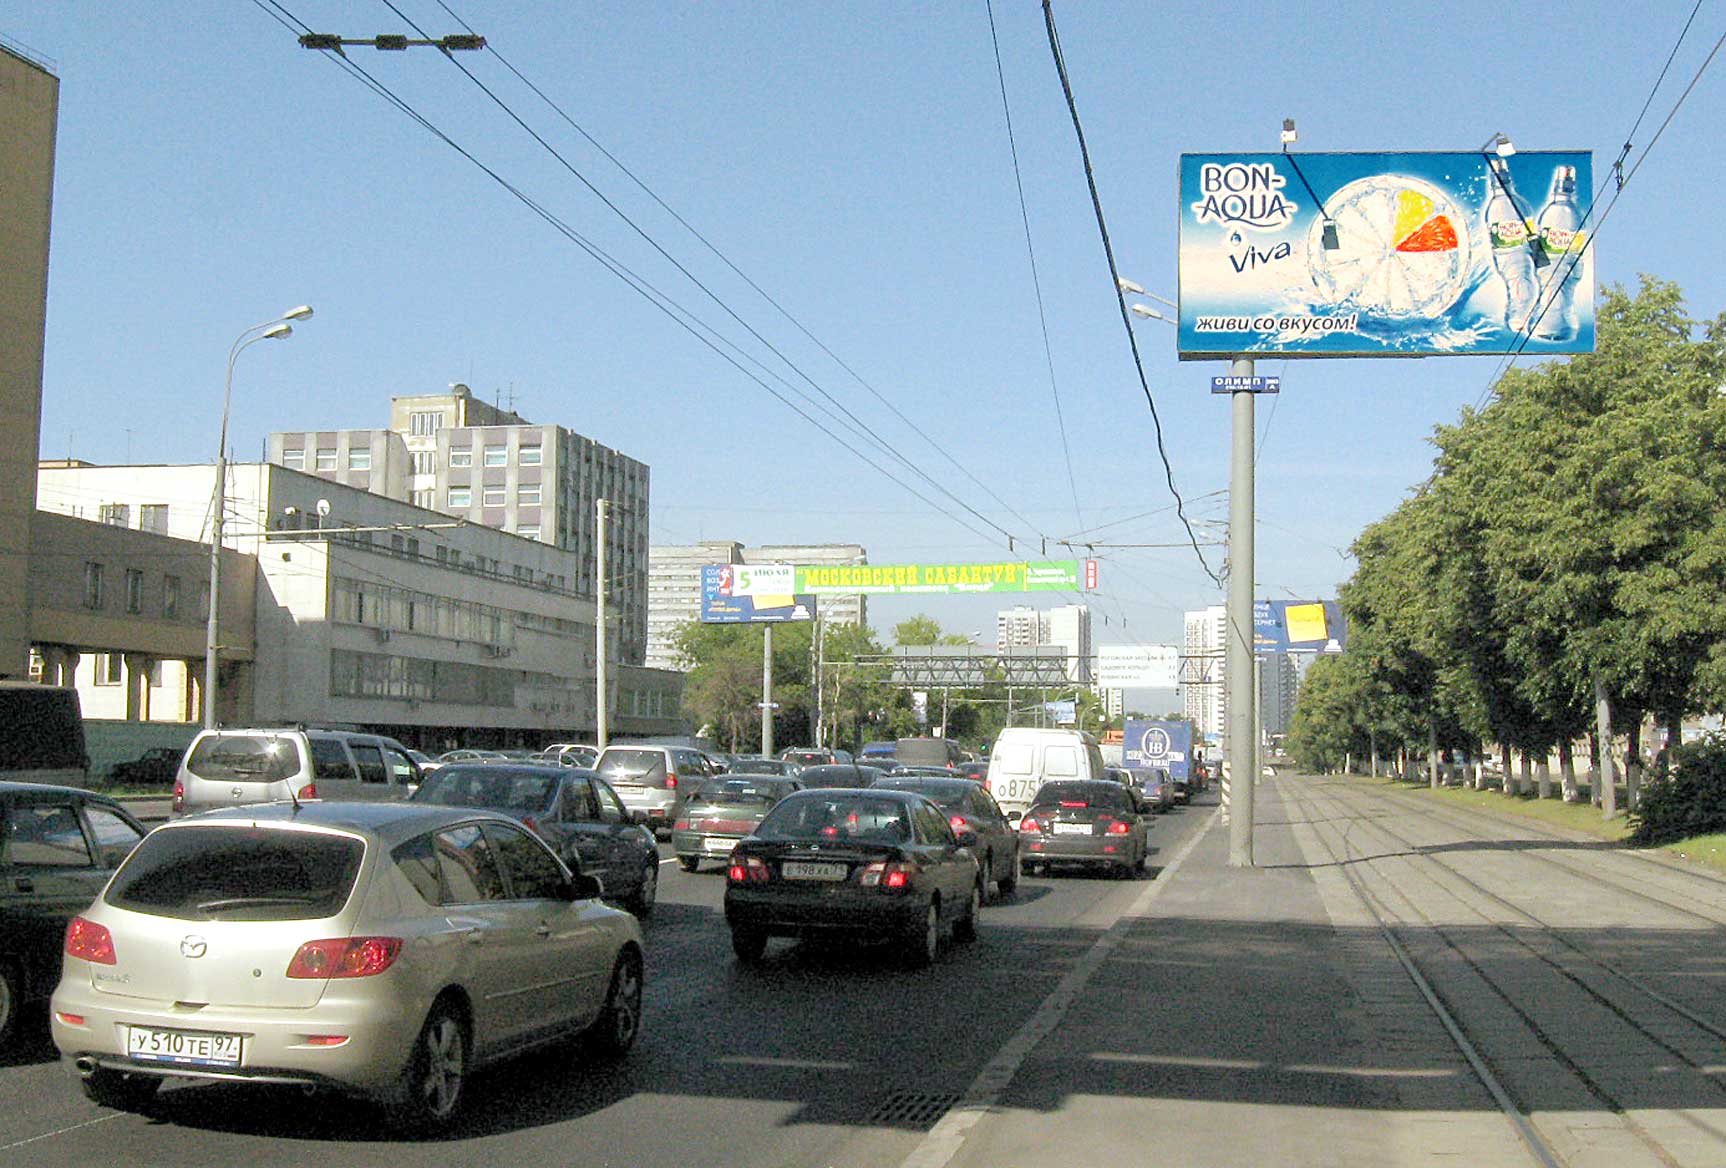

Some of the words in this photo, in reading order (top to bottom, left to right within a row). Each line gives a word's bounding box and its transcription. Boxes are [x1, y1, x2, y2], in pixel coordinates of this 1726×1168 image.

[1204, 165, 1281, 192] BON-
[1195, 194, 1293, 227] AQUA
[1229, 241, 1291, 273] Viva
[1253, 318, 1275, 330] со
[1279, 314, 1356, 333] вкусом!
[1215, 377, 1261, 386] ОЛИМП
[741, 571, 751, 589] 5
